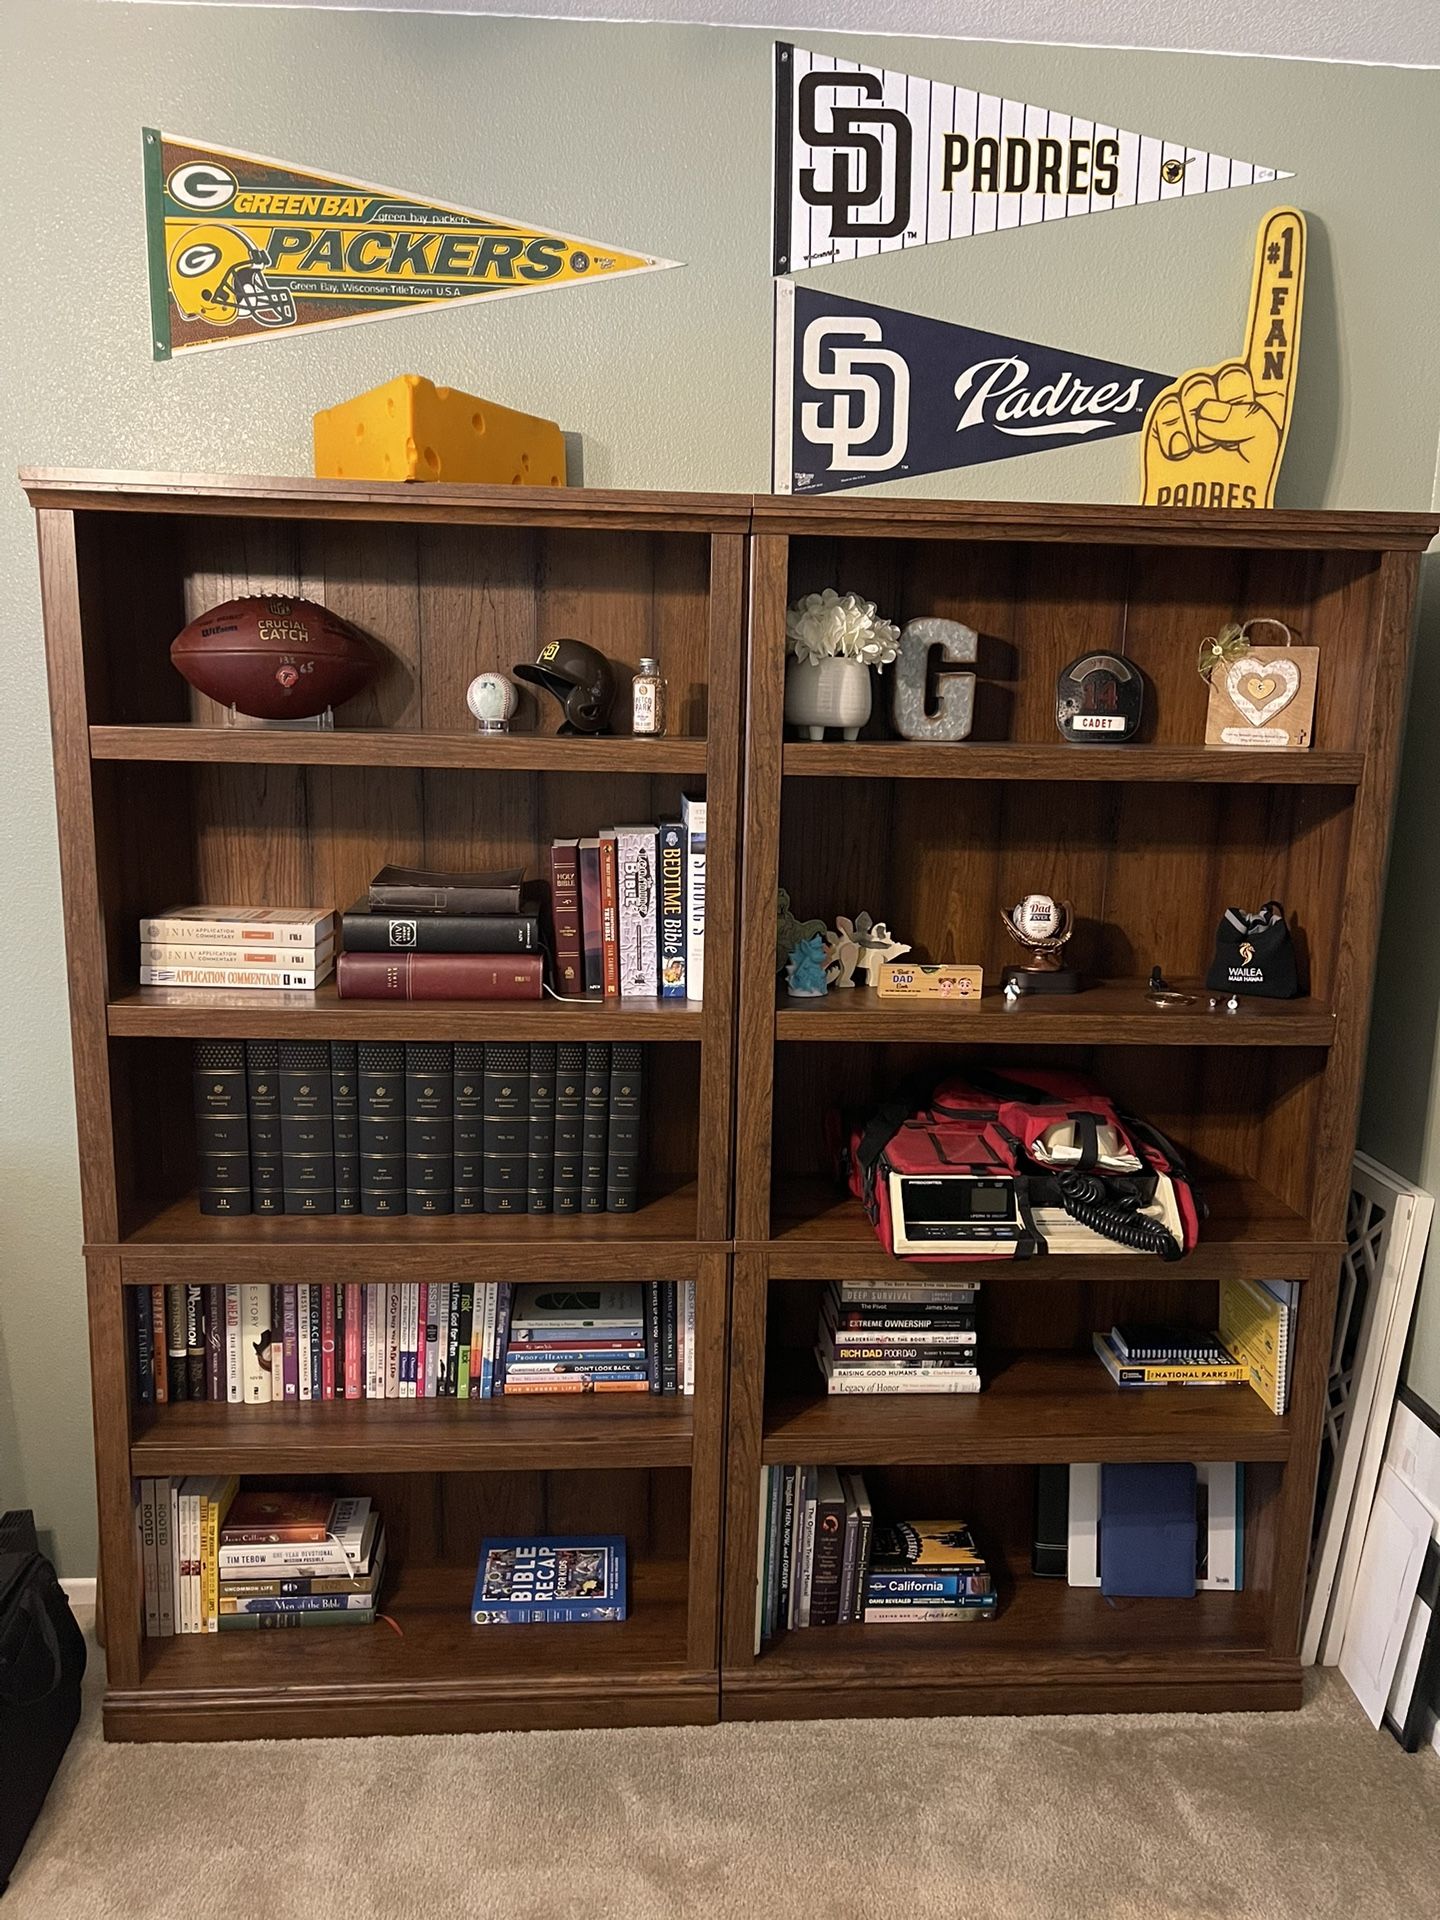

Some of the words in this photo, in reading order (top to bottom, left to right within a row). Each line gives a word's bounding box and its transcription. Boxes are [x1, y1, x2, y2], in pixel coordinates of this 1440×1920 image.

[942, 133, 1120, 196] PADRES
[169, 164, 235, 208] G
[233, 194, 322, 215] GREEN
[320, 196, 374, 217] BAY
[377, 212, 406, 222] green
[410, 212, 428, 224] bay
[432, 214, 471, 225] packers
[178, 245, 217, 276] G
[264, 227, 569, 280] PACKERS
[1266, 227, 1294, 279] #1
[289, 280, 317, 290] Green
[320, 281, 339, 293] Bay,
[1262, 287, 1289, 380] FAN
[953, 354, 1144, 433] Padres
[1157, 481, 1257, 509] PADRES
[257, 618, 309, 631] CRUCIAL
[259, 628, 309, 642] CATCH
[893, 617, 979, 741] G
[1082, 718, 1113, 729] CADET
[623, 861, 638, 908] BIBLE
[663, 848, 682, 916] BEDTIME
[1029, 903, 1052, 913] Dad
[172, 928, 195, 937] NIV
[663, 918, 682, 954] Bible
[174, 951, 197, 960] NIV
[176, 970, 226, 984] APPLICATION
[227, 971, 282, 986] COMMENTARY
[892, 974, 914, 983] DAD
[1228, 967, 1263, 977] WAILEA
[390, 1294, 399, 1315] GOD
[461, 1294, 472, 1313] risk
[847, 1290, 870, 1301] DEEP
[871, 1290, 912, 1301] SURVIVAL
[152, 1291, 163, 1334] SHAKEN
[227, 1297, 239, 1327] AHEAD
[250, 1296, 259, 1328] STORY
[451, 1312, 460, 1326] God
[301, 1315, 309, 1340] TRUTH
[311, 1311, 319, 1344] GRACE
[849, 1319, 883, 1328] EXTREME
[884, 1319, 932, 1328] OWNERSHIP
[138, 1328, 149, 1375] FEARLESS
[450, 1341, 458, 1357] Men
[515, 1353, 538, 1361] PROOF
[545, 1352, 573, 1360] HEAVEN
[840, 1349, 861, 1358] RICH
[862, 1349, 883, 1358] DAD
[883, 1349, 902, 1358] POOR
[902, 1349, 917, 1358] DAD
[1155, 1371, 1199, 1379] NATIONAL
[839, 1382, 865, 1394] Legacy
[866, 1382, 875, 1392] of
[876, 1382, 900, 1392] Honor
[144, 1503, 153, 1546] ROOTED
[158, 1503, 168, 1546] ROOTED
[783, 1508, 792, 1528] THEN,
[242, 1534, 265, 1543] Calling
[783, 1528, 791, 1546] NOW,
[805, 1519, 814, 1548] Optician
[227, 1556, 240, 1564] TIM
[242, 1555, 267, 1563] TEBOW
[558, 1559, 568, 1576] KIDS
[803, 1548, 812, 1574] Training
[510, 1546, 537, 1602] BIBLE
[534, 1546, 557, 1601] RECAP
[558, 1575, 568, 1590] FOR
[781, 1559, 789, 1589] FOREVER
[803, 1574, 811, 1597] Manual
[888, 1581, 944, 1592] California
[274, 1600, 295, 1610] Men
[307, 1600, 320, 1608] the
[321, 1599, 341, 1608] Bible
